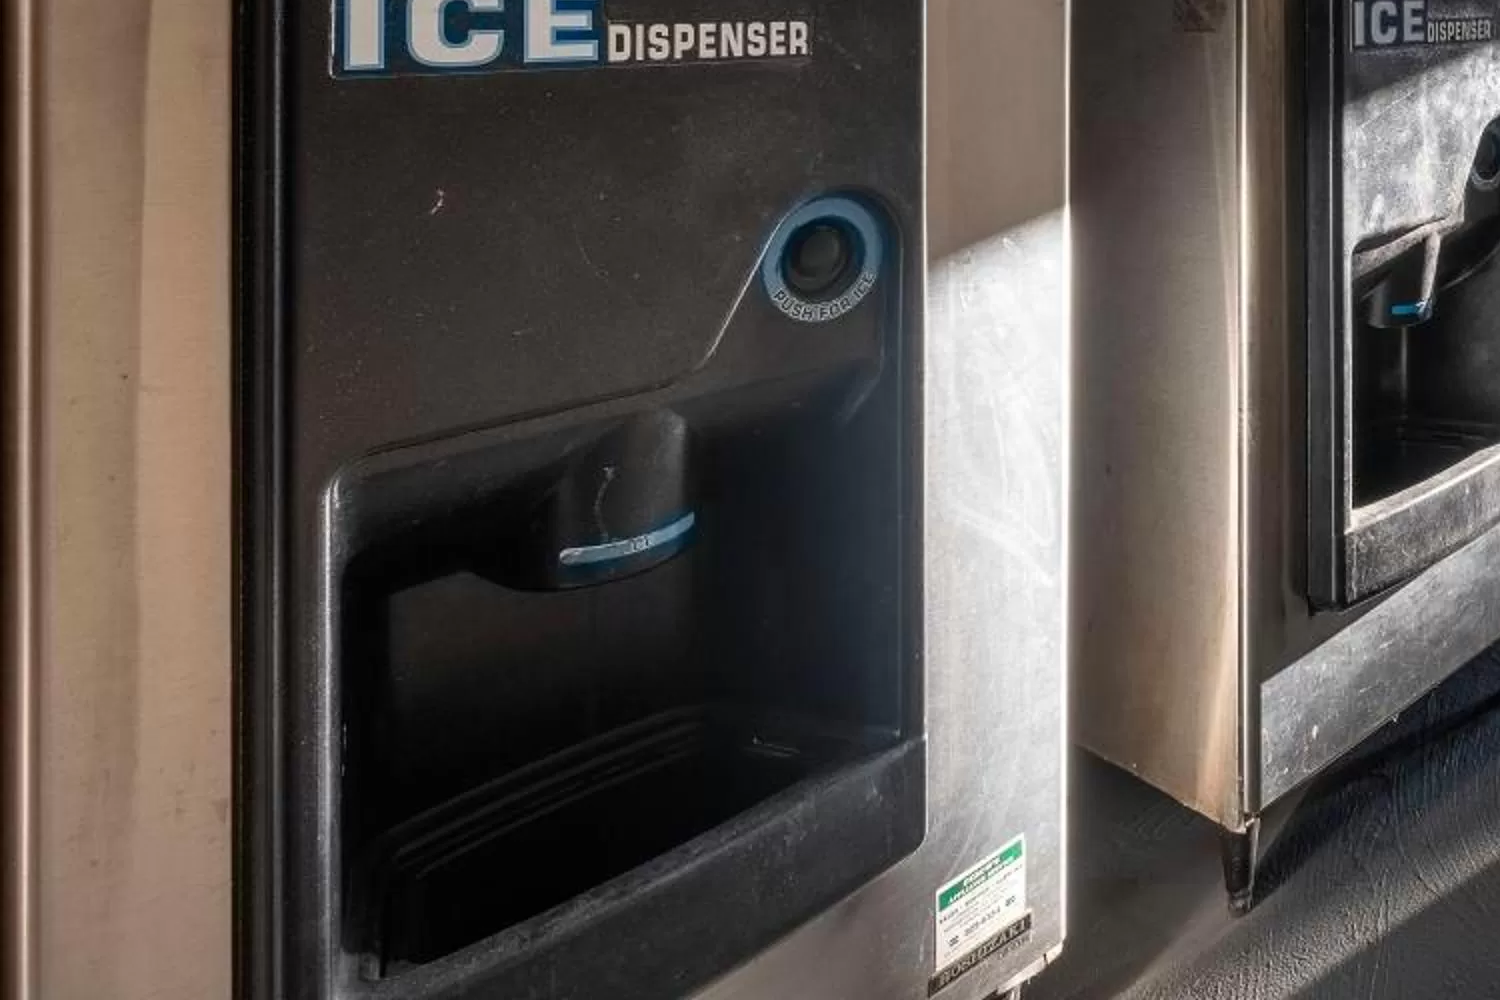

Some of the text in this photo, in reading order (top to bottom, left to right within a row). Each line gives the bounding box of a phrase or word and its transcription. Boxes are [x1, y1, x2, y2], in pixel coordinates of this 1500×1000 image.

[607, 20, 809, 63] DISPENSER
[1353, 0, 1491, 46] ICE DISPENSER
